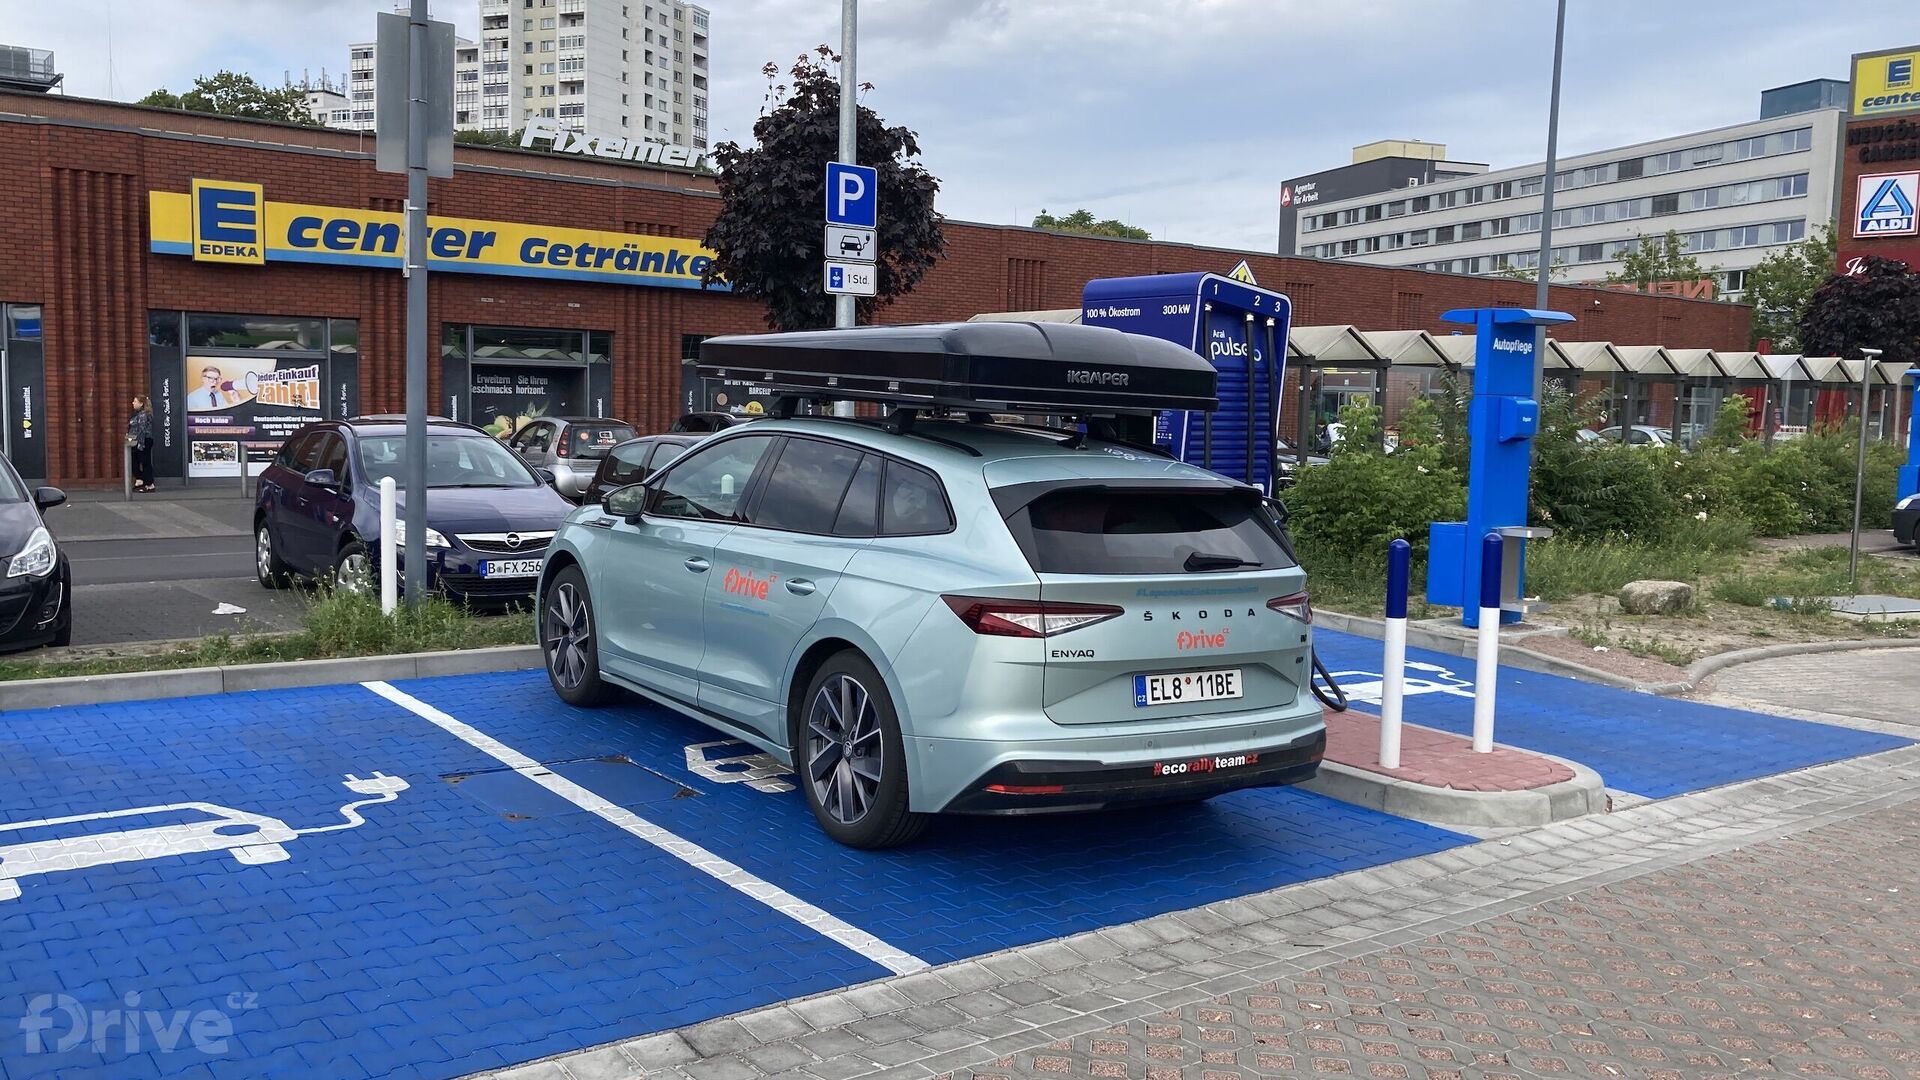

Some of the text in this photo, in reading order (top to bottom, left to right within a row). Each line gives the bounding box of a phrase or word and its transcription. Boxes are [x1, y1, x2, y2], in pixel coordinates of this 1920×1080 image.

[1888, 59, 1912, 82] E
[519, 116, 708, 168] Fixemer
[838, 171, 865, 217] P
[1294, 182, 1317, 195] Agentur
[1293, 191, 1319, 206] für Arbeit
[199, 187, 256, 244] E
[1864, 217, 1910, 232] ALDI
[200, 244, 259, 258] EDEKA
[287, 215, 712, 277] cener Getränke
[847, 274, 870, 285] 1 Std.
[1213, 284, 1219, 296] 1
[1254, 295, 1261, 307] 2
[1274, 301, 1281, 313] 3
[1086, 303, 1191, 319] 100 % Ökostrom 300 kW
[1213, 329, 1226, 338] Aral
[1493, 337, 1533, 353] Autopflege
[278, 367, 317, 380] Einkauf
[477, 374, 548, 385] Erweitern Sie Ihren
[488, 563, 496, 573] B
[504, 562, 519, 573] FX
[1143, 608, 1256, 622] ŠKODA
[1051, 650, 1095, 658] ENYAQ
[1137, 673, 1235, 703] CZ EL8 11BE
[1153, 753, 1259, 776] #ecorallyteamcz
